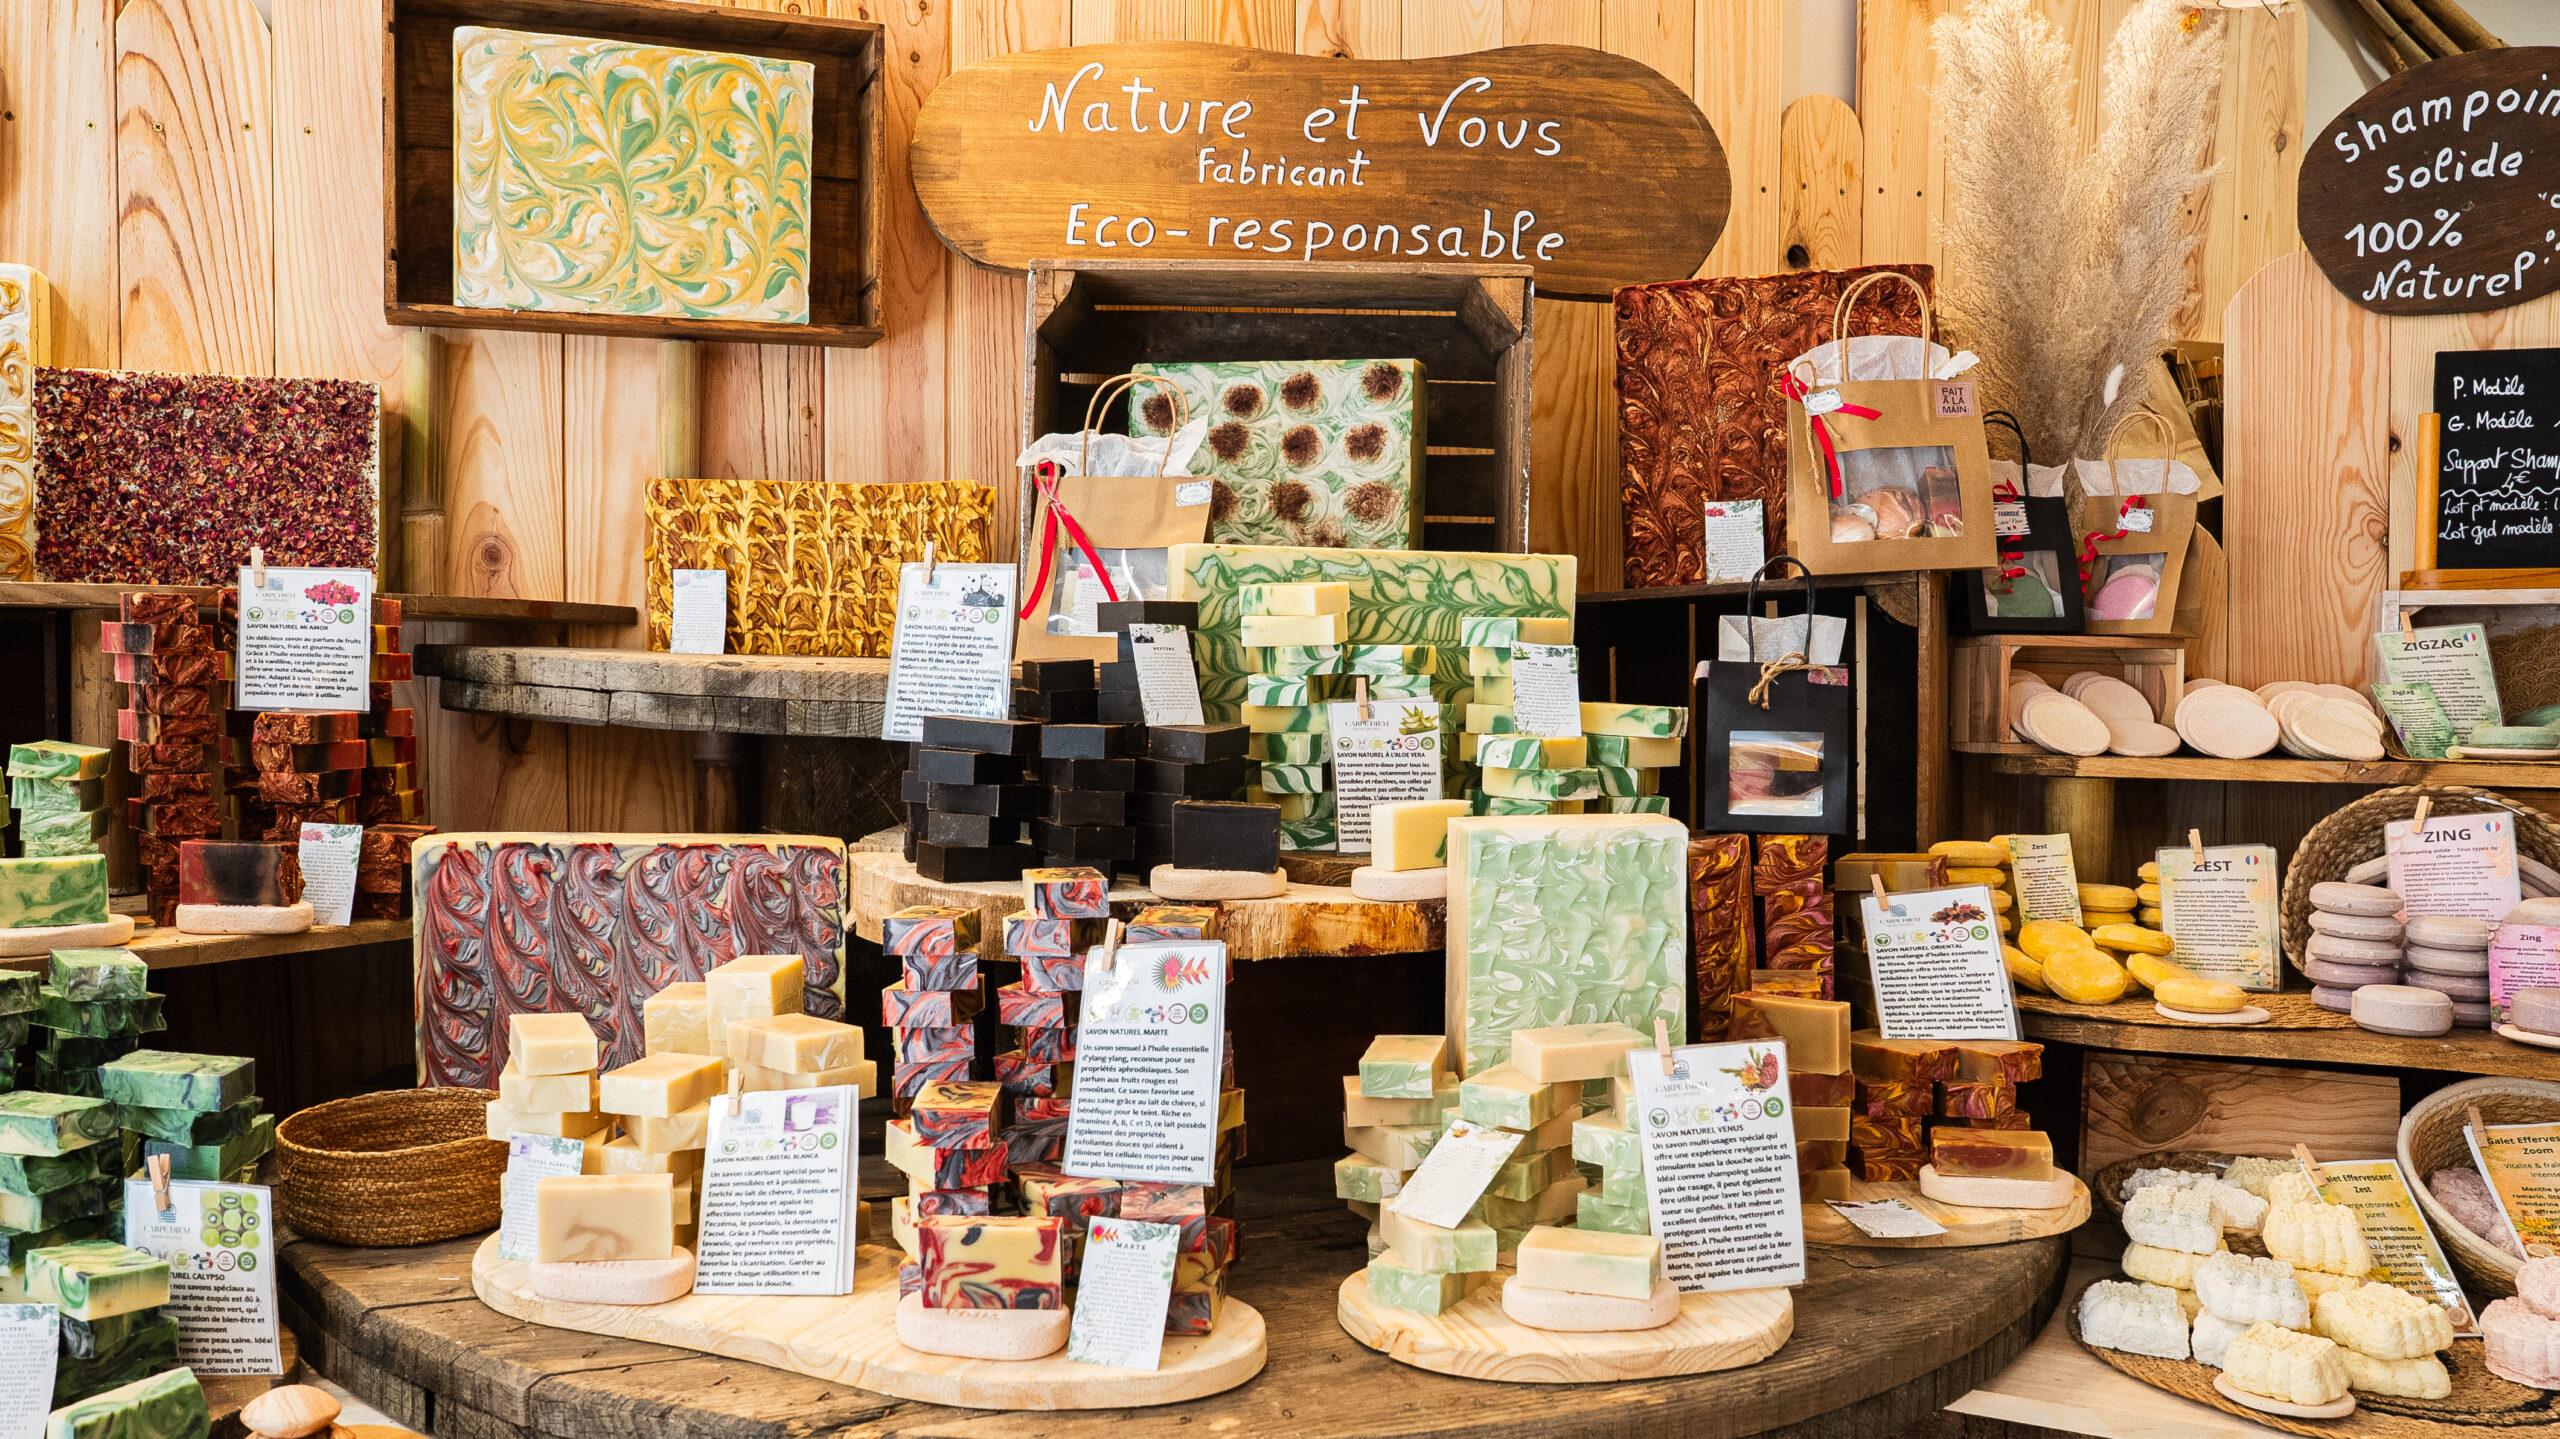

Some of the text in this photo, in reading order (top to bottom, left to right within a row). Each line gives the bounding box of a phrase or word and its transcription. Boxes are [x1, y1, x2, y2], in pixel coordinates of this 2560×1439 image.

[1029, 62, 1561, 156] Nature et Vous
[1198, 147, 1371, 187] Fabricant
[2384, 141, 2523, 194] solide
[2344, 208, 2463, 257] 100%
[1941, 387, 1963, 396] FAIT
[2453, 374, 2525, 400] P. Modèle
[1952, 396, 1965, 405] LA
[1942, 405, 1967, 414] MAIN
[2447, 408, 2535, 432] G. Modèle
[2443, 446, 2508, 484] Support
[2444, 497, 2470, 515] Lot
[2471, 497, 2490, 522] pt
[2438, 519, 2470, 541] Lot
[2501, 515, 2553, 536] modèle
[2402, 638, 2464, 652] ZIGZAG
[2424, 829, 2472, 843] ZING
[2193, 860, 2233, 872] ZEST
[2520, 933, 2542, 943] Zing
[1085, 1028, 1109, 1036] SAVON
[1109, 1028, 1142, 1036] NATUREL
[1170, 1045, 1209, 1053] essentielle
[1080, 1065, 1117, 1074] propriétés
[1118, 1066, 1173, 1075] aphrodisiaques.
[1680, 1127, 1716, 1136] NATUREL
[1717, 1124, 1744, 1133] VENUS
[1689, 1137, 1737, 1147] multi-usages
[1739, 1133, 1765, 1143] spécial
[1765, 1132, 1778, 1141] qui
[2523, 1147, 2553, 1155] Zoom
[744, 1169, 781, 1177] cicatrisant
[783, 1168, 808, 1176] spécial
[2342, 1174, 2394, 1182] Effervescent
[213, 1284, 245, 1293] spéciaux
